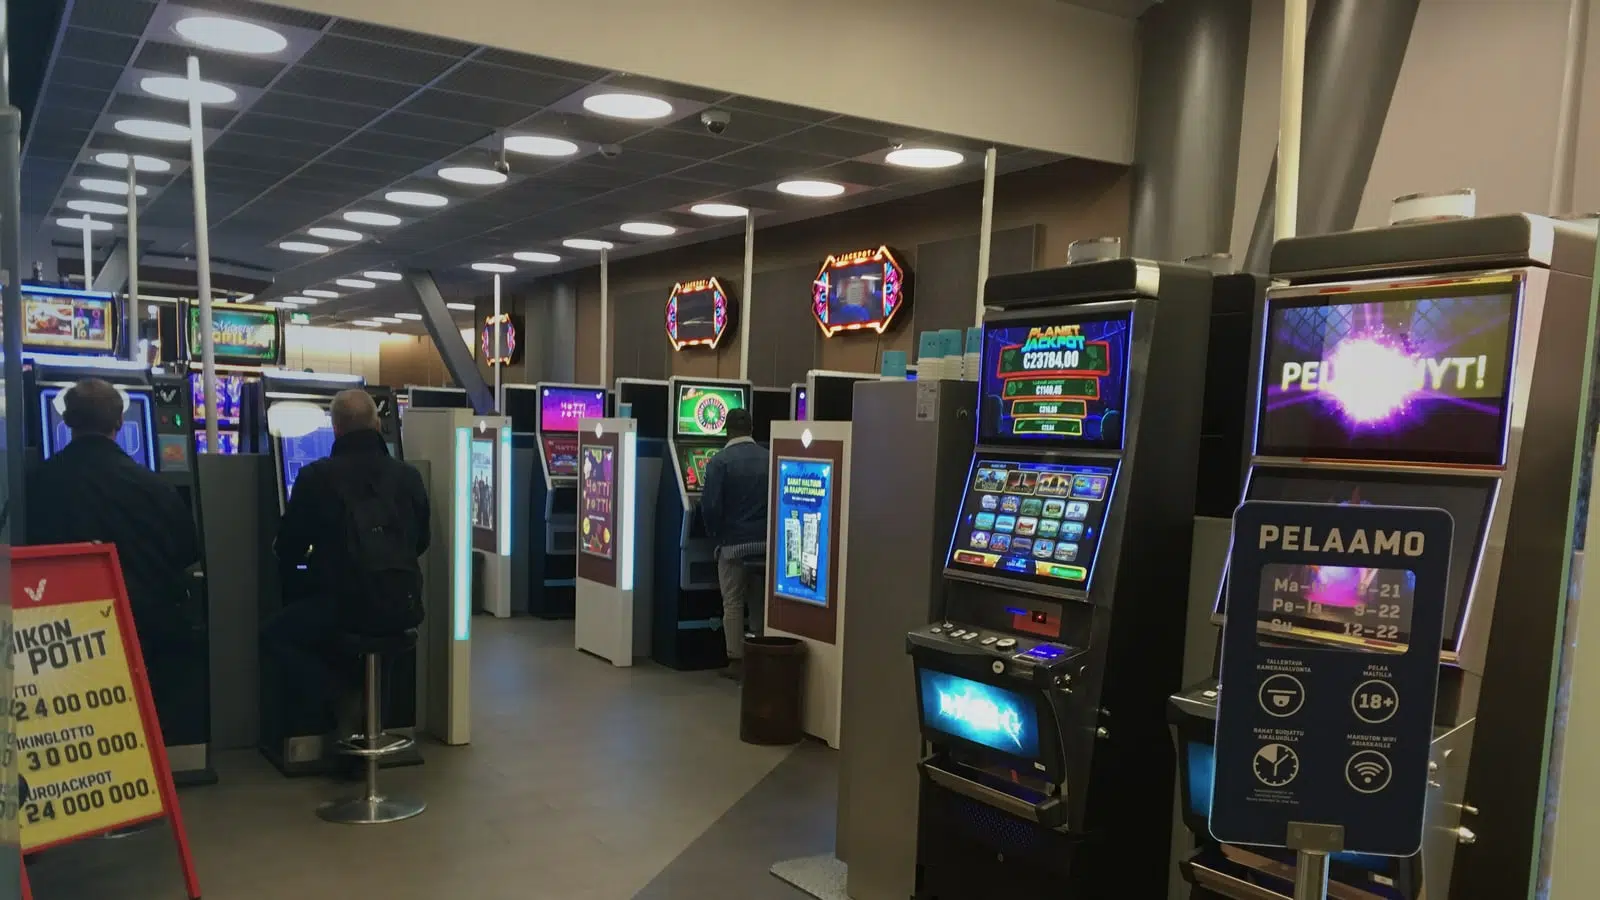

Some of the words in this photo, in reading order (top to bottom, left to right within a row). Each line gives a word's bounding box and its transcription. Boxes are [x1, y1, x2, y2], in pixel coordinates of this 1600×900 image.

[841, 249, 872, 262] JACKPOT
[1028, 325, 1080, 340] PLANET
[1020, 335, 1086, 352] JACKPOT
[561, 402, 586, 411] HOTTI
[562, 410, 585, 418] POTTI
[586, 480, 611, 497] HOTTI
[1259, 524, 1425, 557] PELAAMO
[1354, 603, 1401, 619] 9-22
[13, 618, 72, 654] IKON
[1343, 622, 1399, 639] 12-22
[28, 630, 106, 676] POTIT
[14, 683, 38, 698] TTO
[1359, 693, 1394, 709] 18+
[17, 724, 95, 751] IKINGLOTTO
[27, 770, 112, 802] UROJACKPOT
